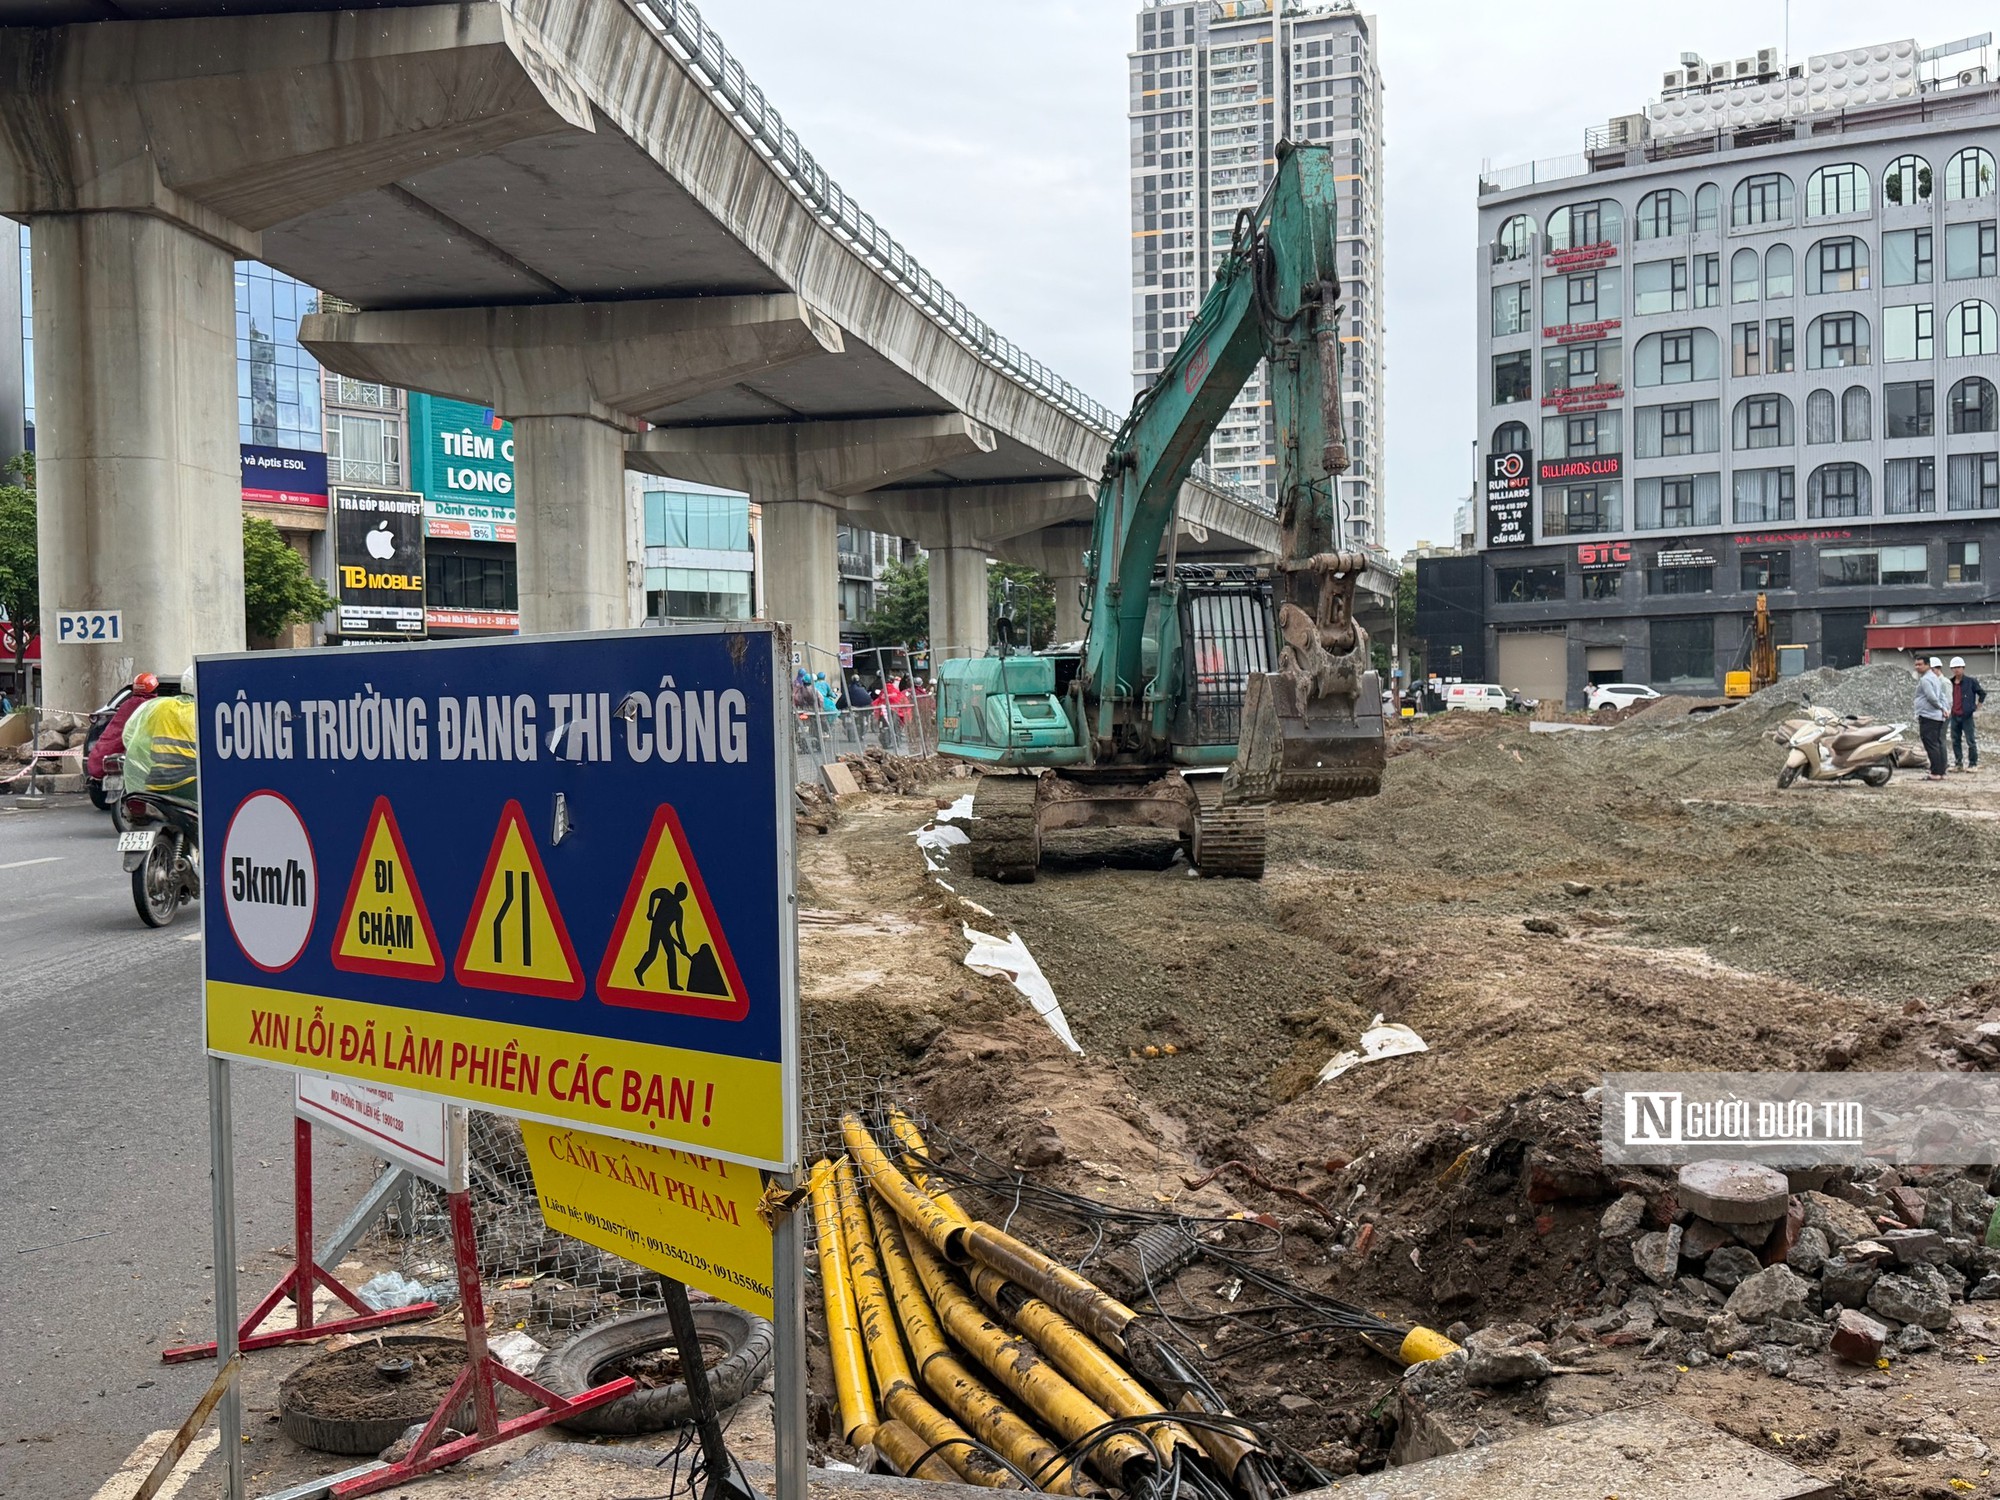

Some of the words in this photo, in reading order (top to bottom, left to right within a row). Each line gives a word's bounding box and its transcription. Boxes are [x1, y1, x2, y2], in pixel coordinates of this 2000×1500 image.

[441, 428, 494, 459] TIÊM
[244, 454, 256, 465] và
[258, 456, 281, 468] Aptis
[283, 459, 306, 470] ESOL
[1542, 461, 1590, 478] BILLIARDS
[1592, 459, 1618, 474] CLUB
[447, 467, 512, 494] LONG
[1489, 479, 1508, 490] RUN
[1509, 477, 1530, 488] OUT
[340, 494, 358, 511] TRẢ
[359, 497, 377, 512] GÓP
[379, 501, 395, 513] BAO
[396, 501, 420, 516] DUYỆT
[1489, 488, 1530, 500] BILLIARDS
[436, 503, 465, 515] Dành
[468, 507, 488, 517] cho
[491, 507, 506, 519] trẻ
[473, 530, 489, 538] 8%
[1501, 522, 1519, 531] 201
[340, 566, 367, 588] TB
[369, 573, 422, 590] MOBILE
[60, 615, 119, 640] P321
[215, 690, 293, 760] CÔNG
[301, 682, 428, 761] TRƯỜNG
[438, 694, 537, 761] ĐANG
[548, 692, 612, 762] THI
[622, 675, 748, 763] CÔNG
[232, 857, 306, 907] 5km/h
[374, 860, 393, 893] ĐI
[359, 906, 413, 955] CHẬM
[249, 1010, 290, 1050] XIN
[295, 1006, 334, 1058] LỖI
[340, 1020, 376, 1066] ĐÃ
[384, 1026, 443, 1078] LÀM
[450, 1039, 541, 1096] PHIỀN
[548, 1053, 614, 1109] CÁC
[620, 1070, 694, 1130] BẠN
[340, 1093, 354, 1110] THÔNG
[363, 1102, 372, 1118] LIÊN
[549, 1131, 600, 1174] CẤM
[602, 1154, 661, 1197] XÂM
[663, 1175, 741, 1227] PHẠM
[544, 1196, 567, 1214] Liên
